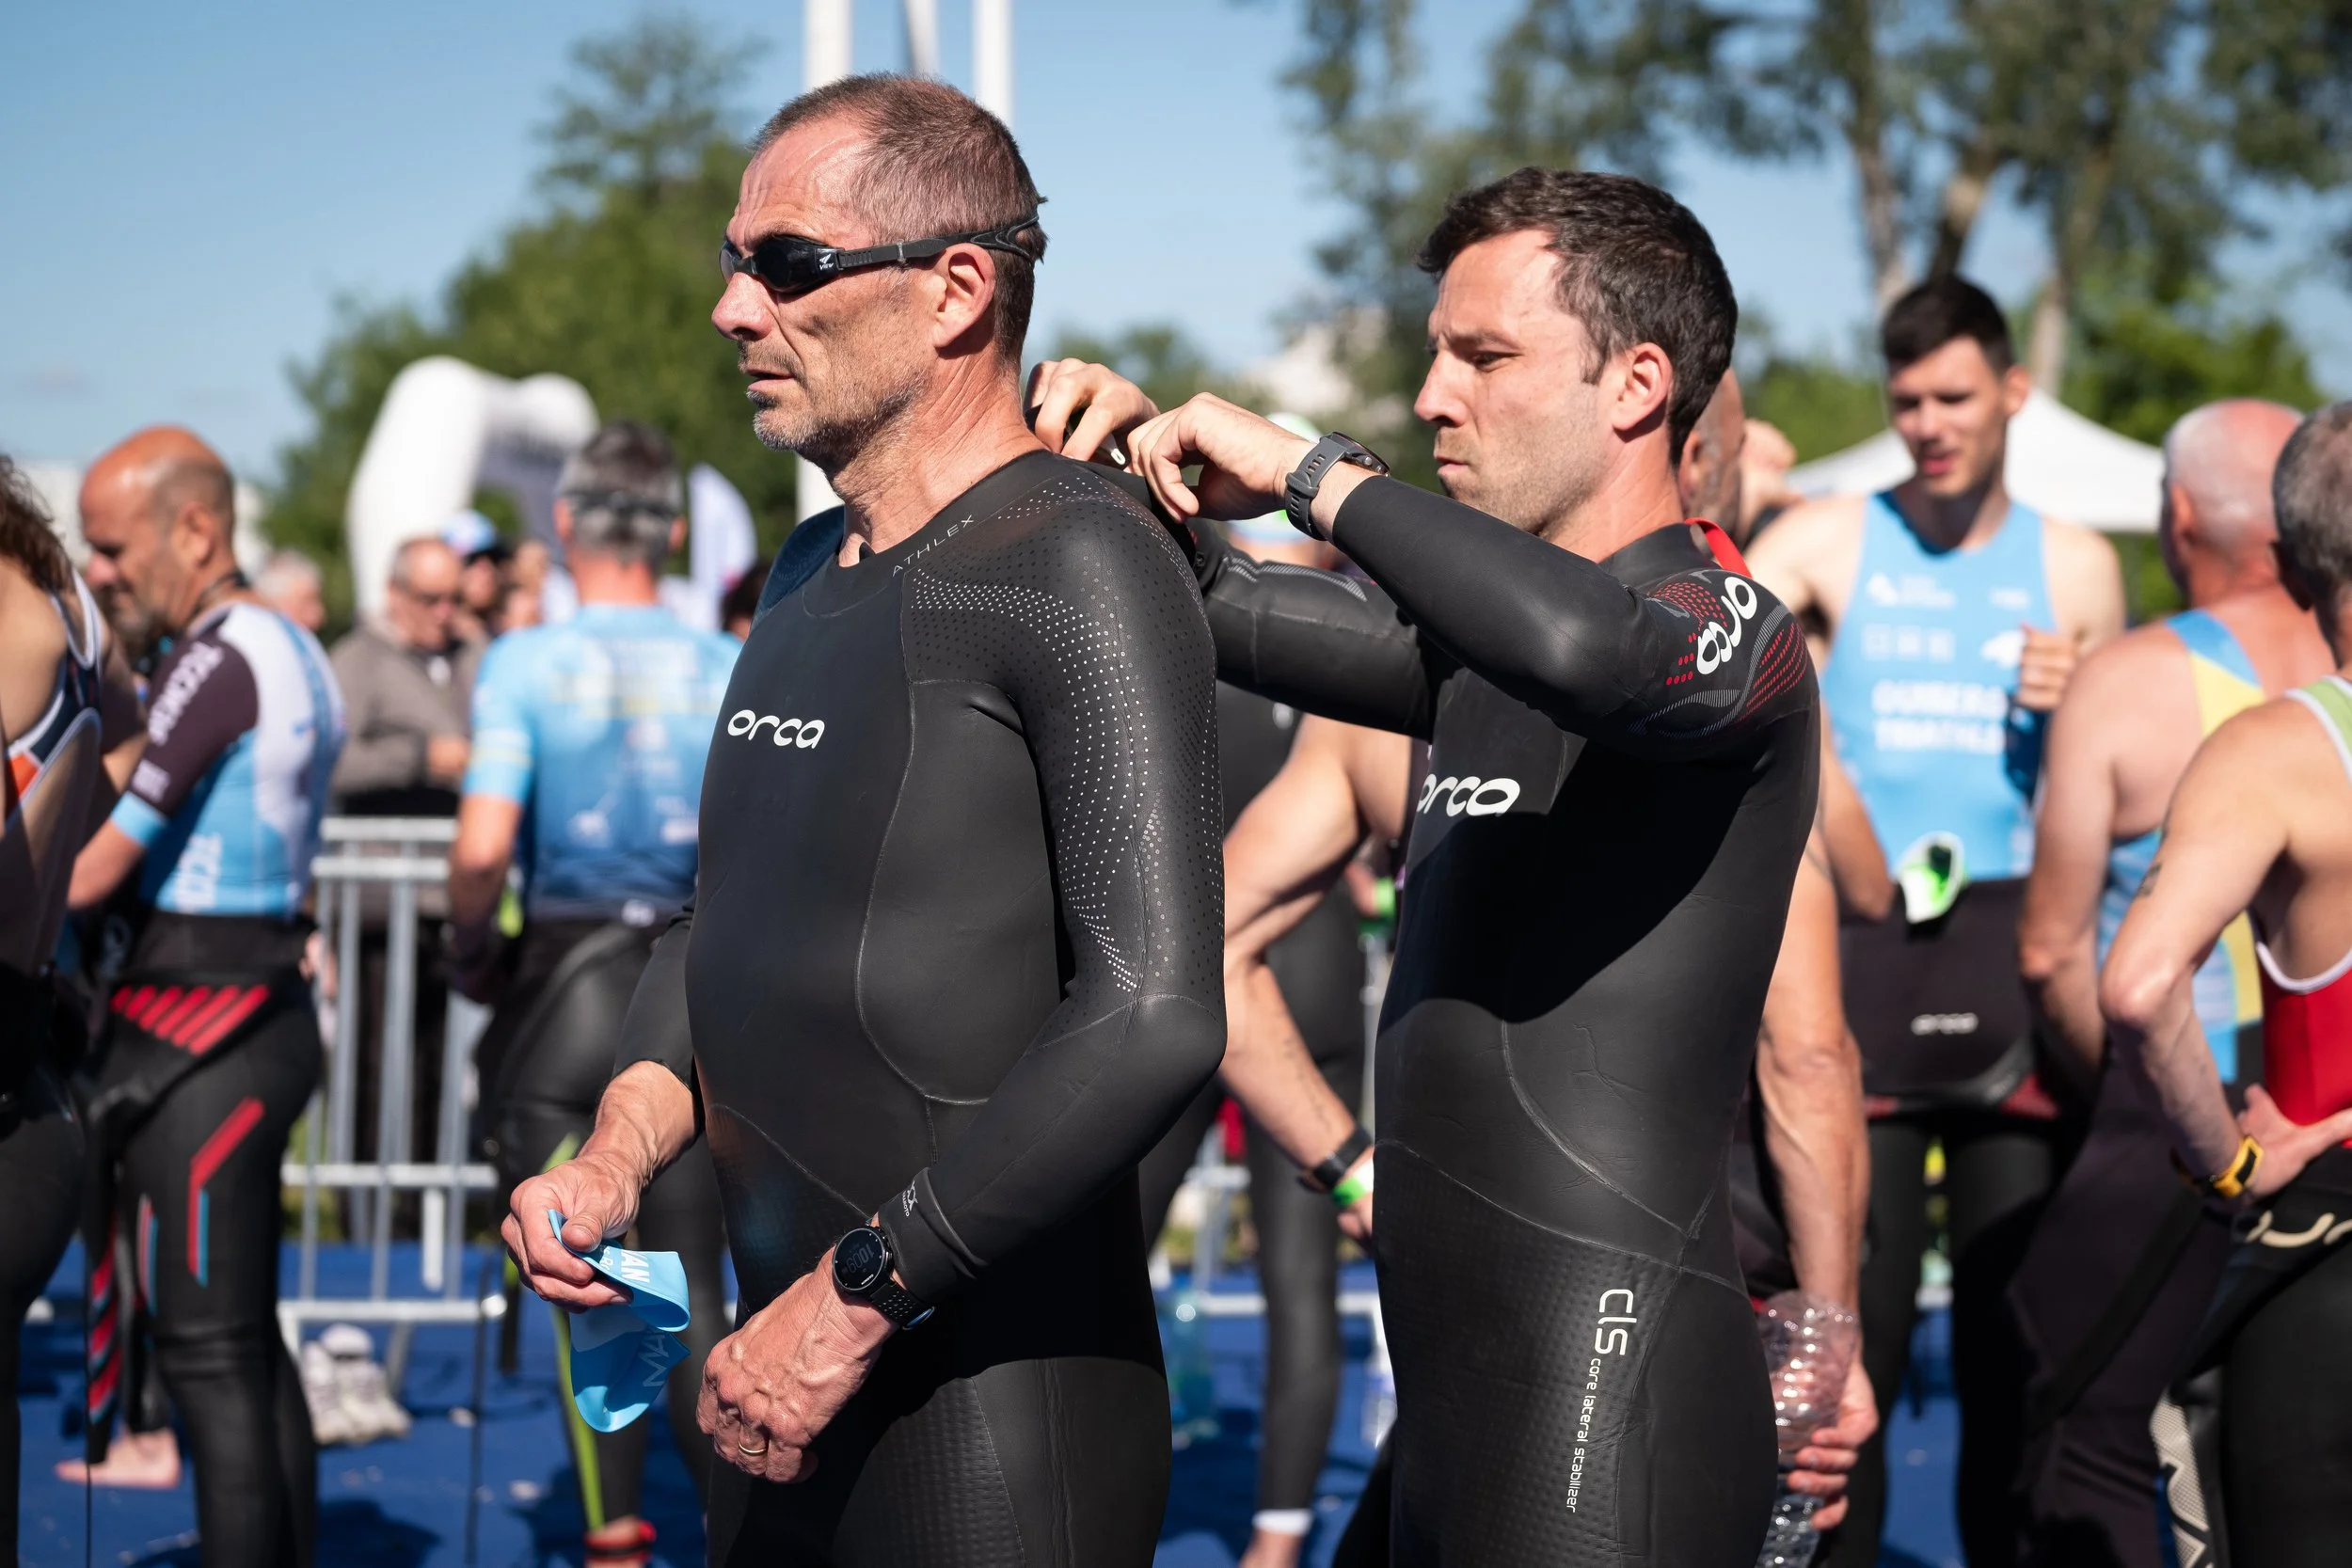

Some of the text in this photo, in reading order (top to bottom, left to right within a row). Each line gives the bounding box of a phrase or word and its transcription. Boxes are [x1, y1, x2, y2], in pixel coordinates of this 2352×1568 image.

[892, 515, 974, 578] ATHLEX
[1696, 576, 1757, 675] orca
[727, 709, 825, 749] orca
[1416, 773, 1520, 817] orca
[1566, 1289, 1637, 1513] cls core lateral stabilizer
